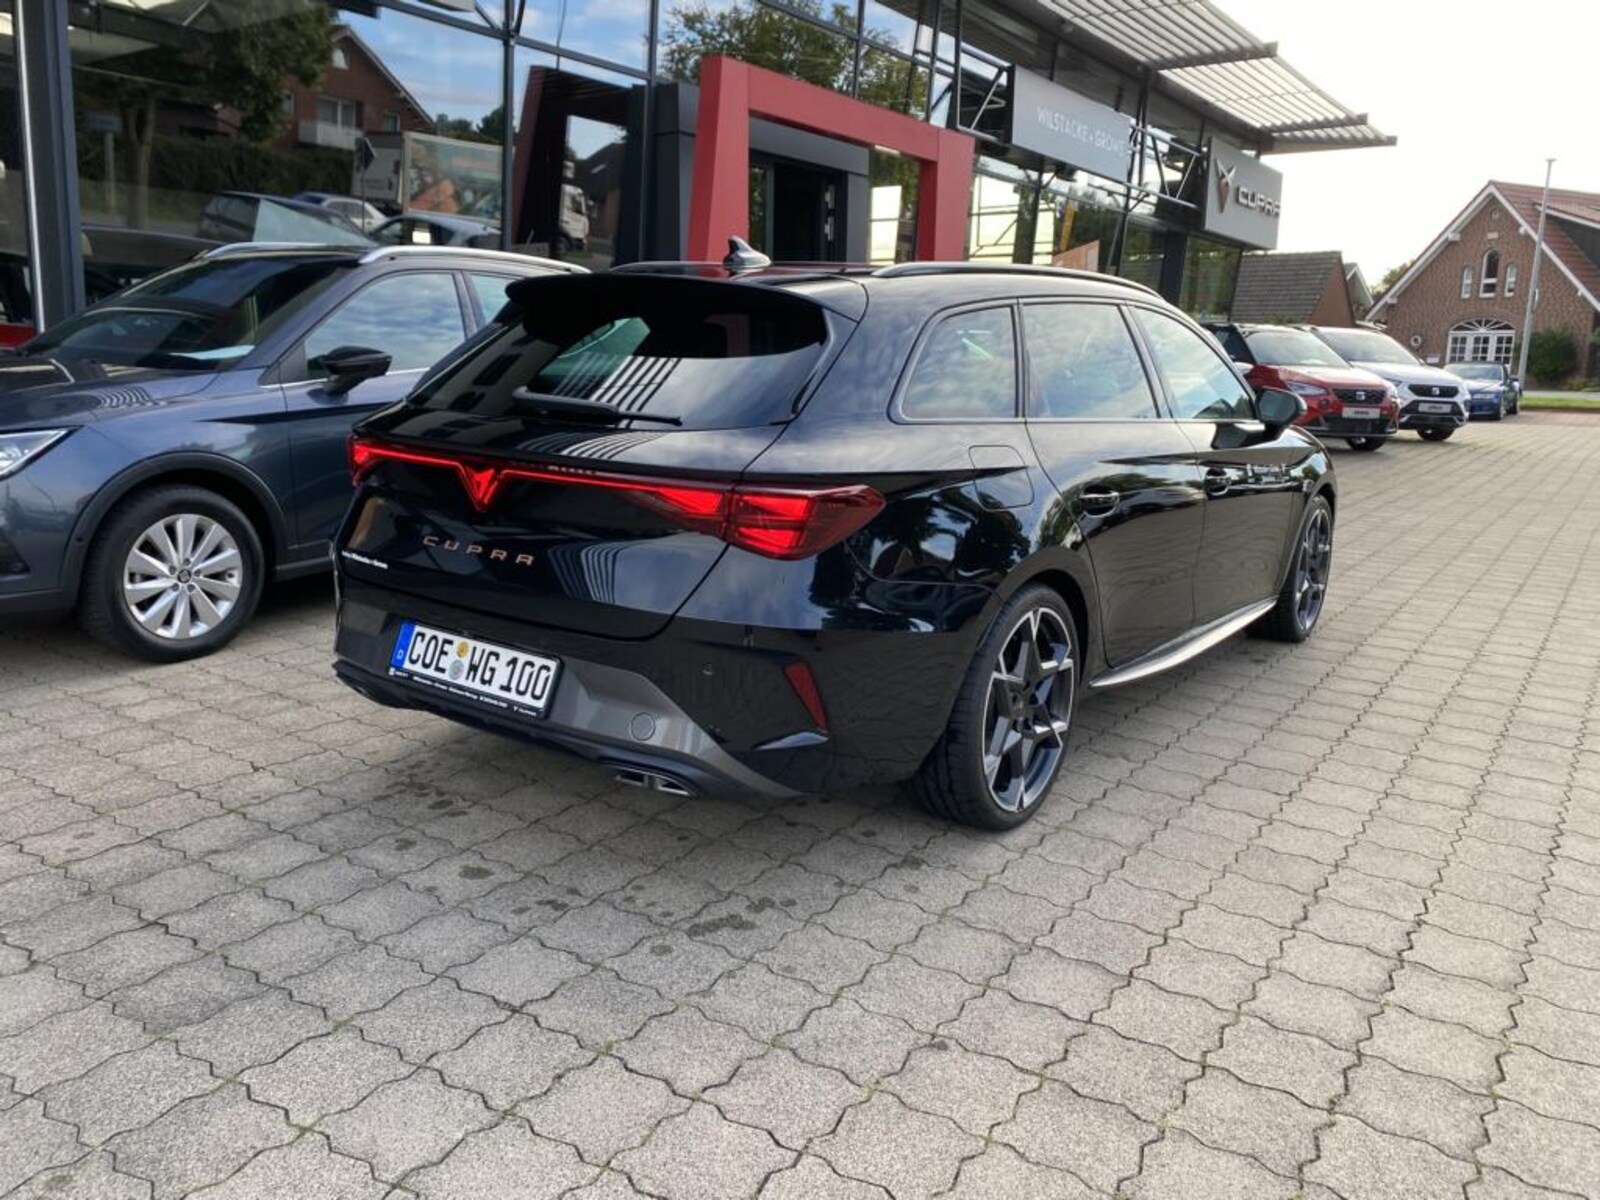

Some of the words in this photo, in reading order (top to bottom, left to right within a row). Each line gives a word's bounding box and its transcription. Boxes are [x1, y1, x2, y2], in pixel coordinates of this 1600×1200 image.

[422, 534, 535, 567] CUPRA
[408, 631, 454, 674] COE
[465, 645, 501, 687] WG
[499, 656, 552, 701] 100
